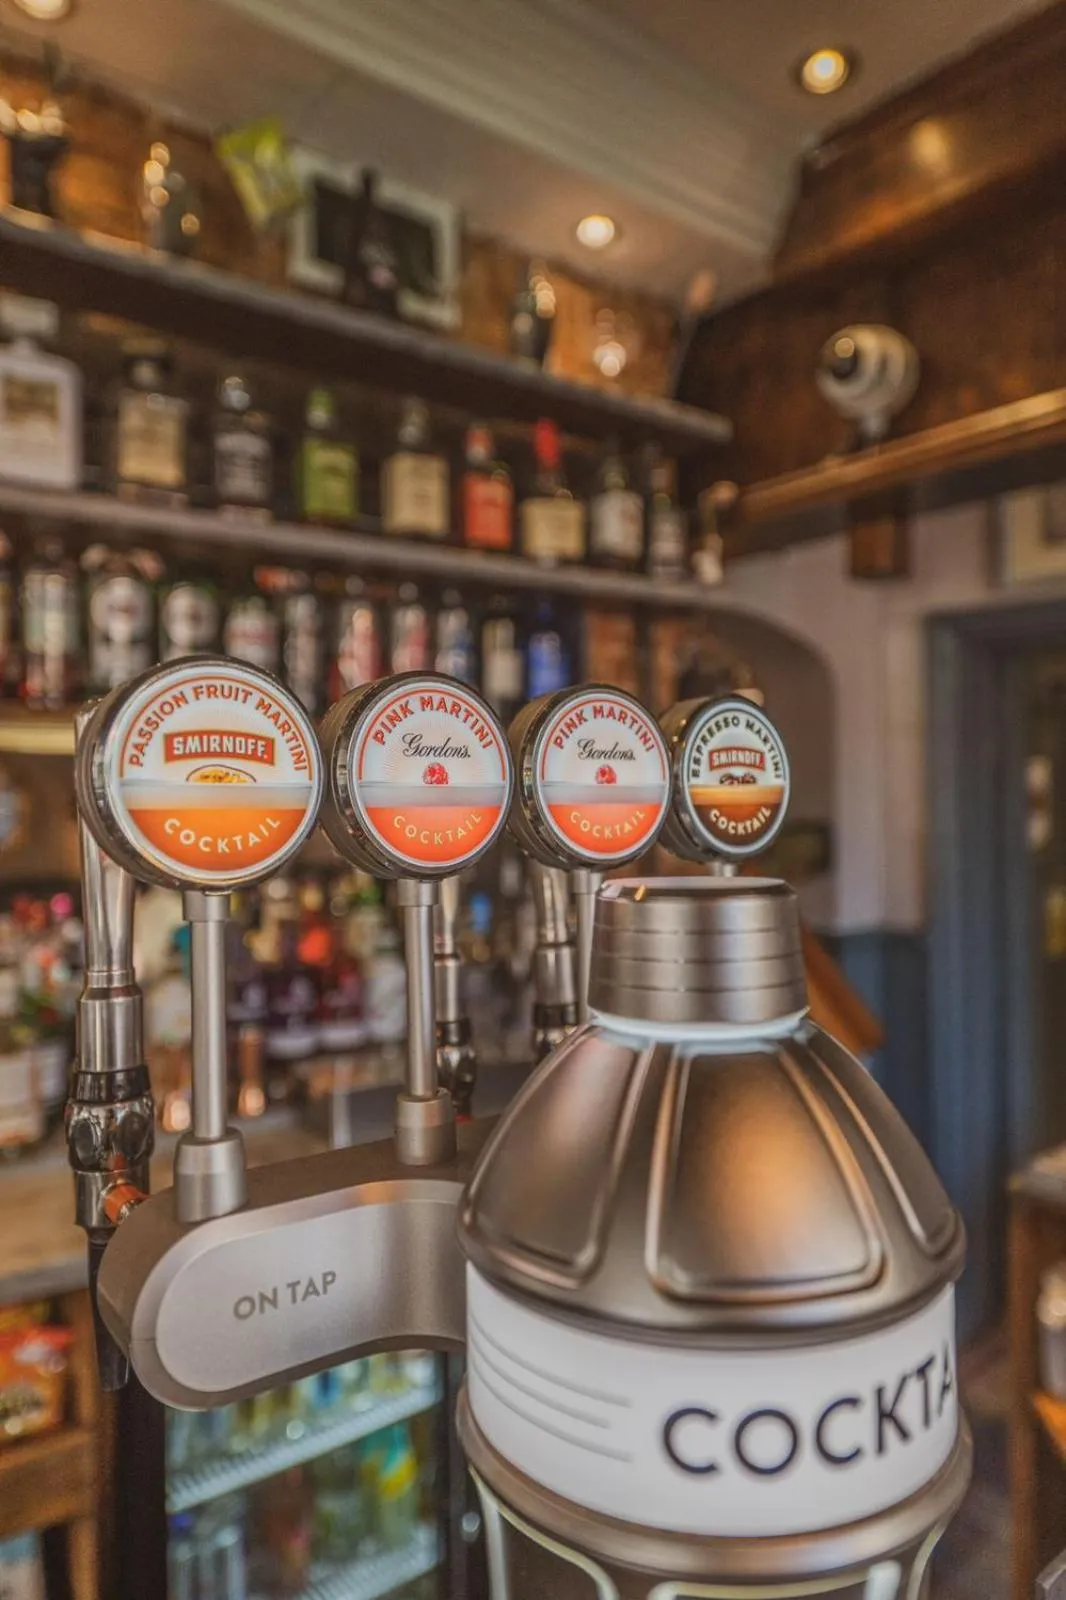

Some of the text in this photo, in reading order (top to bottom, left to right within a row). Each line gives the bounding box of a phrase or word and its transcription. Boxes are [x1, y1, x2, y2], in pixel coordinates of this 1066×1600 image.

[128, 684, 308, 771] PASSION FRUIT MARTINI
[372, 696, 494, 749] PINK MARTINI
[553, 705, 655, 752] PINK MARTINI
[692, 715, 782, 778] ESPRESSO MARTINI
[164, 816, 280, 853] COCKTAIL
[393, 813, 481, 845] COCKTAIL
[570, 811, 646, 840] COCKTAIL
[710, 806, 772, 835] COCKTAIL
[233, 1270, 337, 1320] ON TAP
